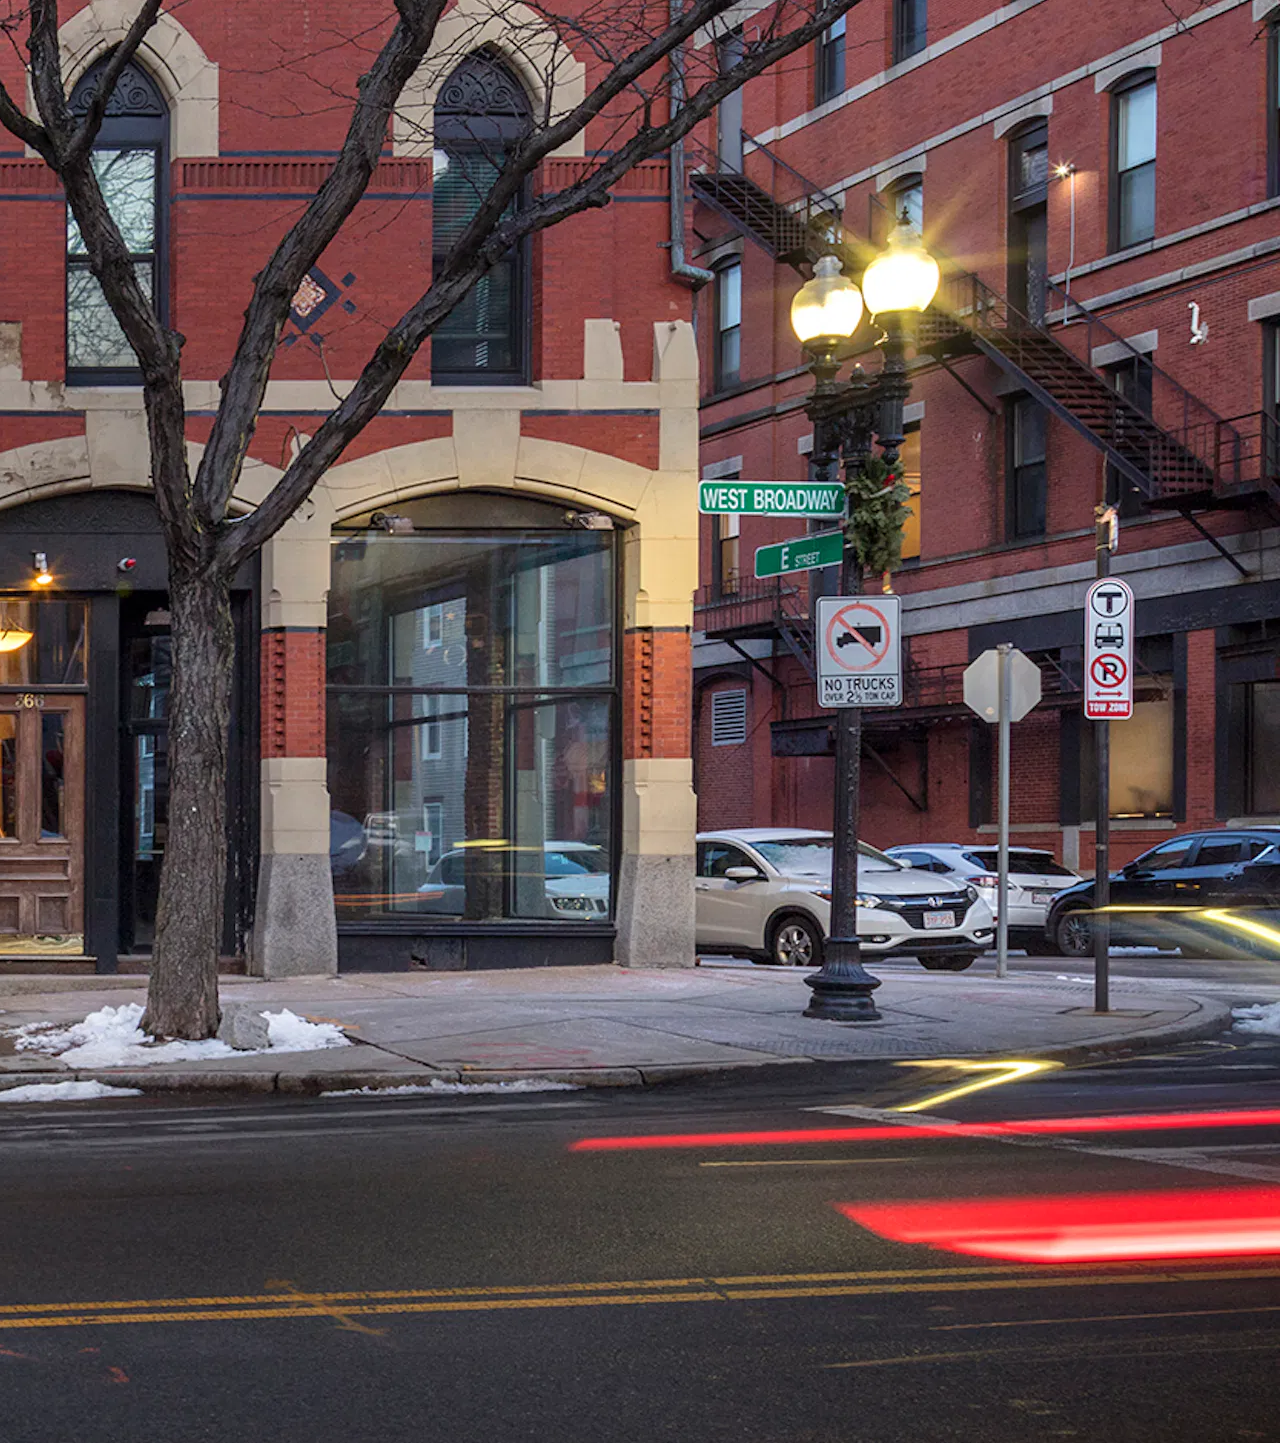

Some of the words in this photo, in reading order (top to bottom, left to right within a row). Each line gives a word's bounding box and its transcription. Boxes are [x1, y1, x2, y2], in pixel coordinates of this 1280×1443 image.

[703, 488, 748, 509] WEST
[753, 489, 838, 510] BROADWAY
[781, 546, 790, 570] E
[794, 551, 820, 568] STREET
[825, 679, 842, 690] NO
[846, 678, 895, 690] TRUCKS
[824, 693, 843, 701] OVER
[1089, 702, 1107, 712] TOW
[1109, 702, 1129, 712] ZONE
